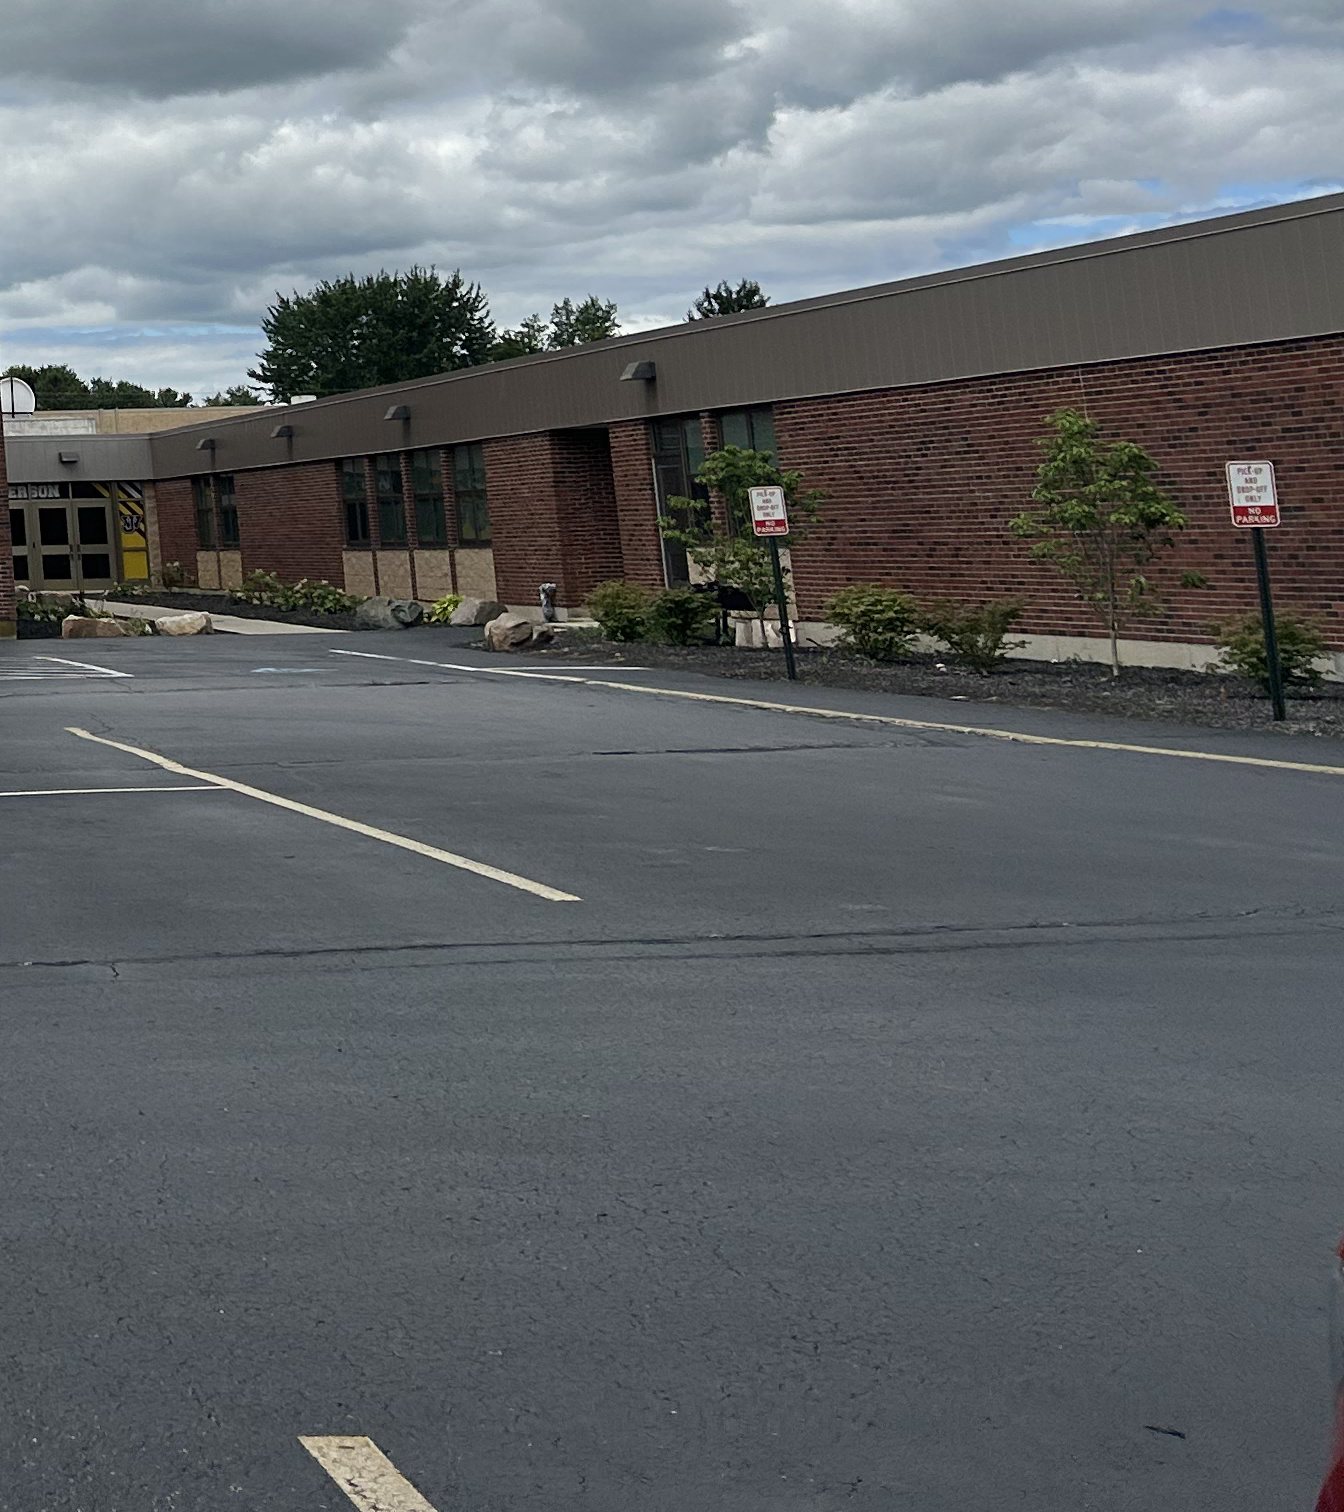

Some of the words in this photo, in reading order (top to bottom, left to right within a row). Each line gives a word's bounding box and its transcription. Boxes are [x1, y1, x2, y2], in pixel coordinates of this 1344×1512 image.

[1237, 467, 1262, 475] PICK-UP
[8, 485, 60, 498] ERSON
[1236, 485, 1267, 493] DROP-OFF
[1248, 507, 1261, 515] NO
[1235, 515, 1276, 523] PARKING
